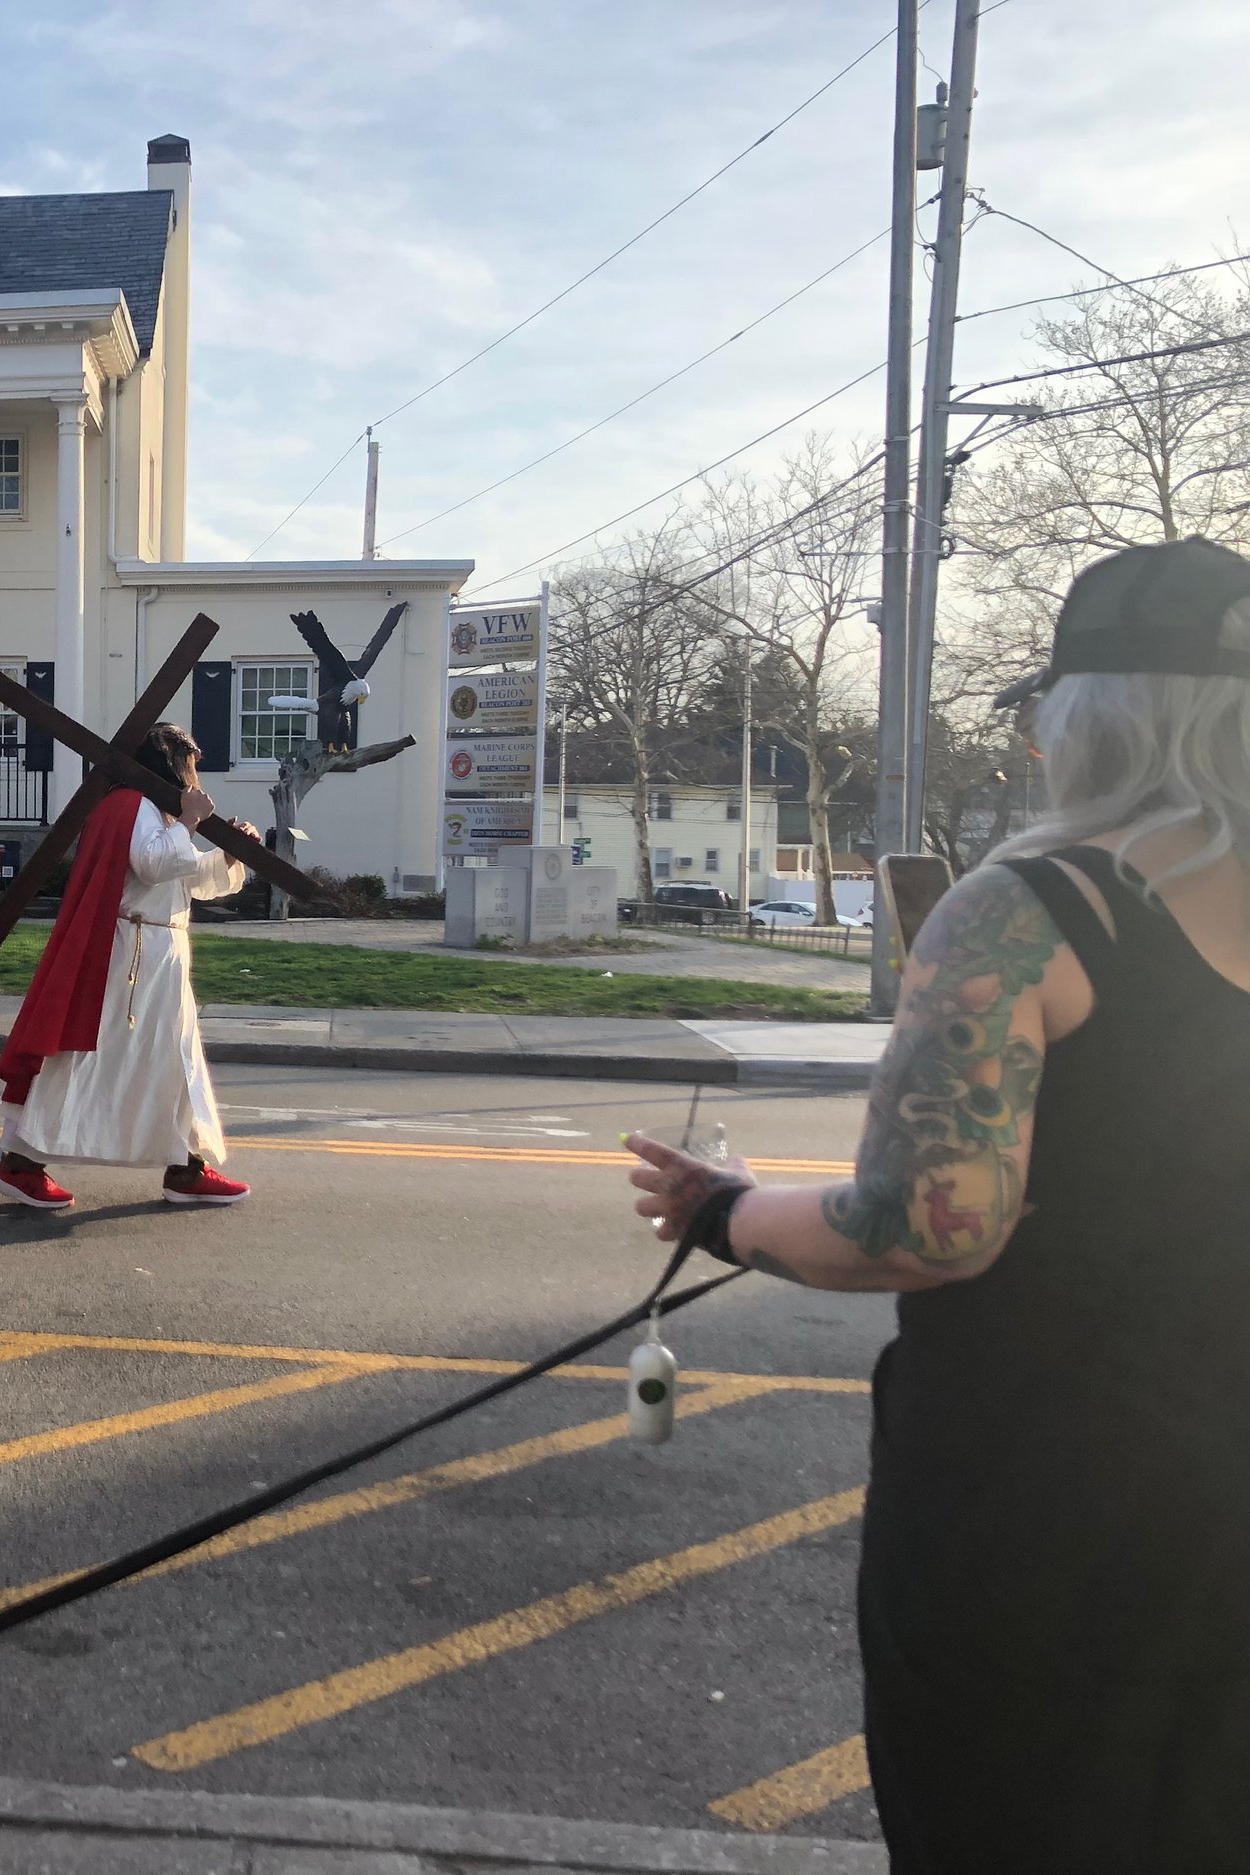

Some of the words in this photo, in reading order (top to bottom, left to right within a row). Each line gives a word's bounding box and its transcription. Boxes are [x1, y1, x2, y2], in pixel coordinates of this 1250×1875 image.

[482, 613, 532, 634] VFW
[478, 675, 534, 688] AMERICAN
[485, 689, 526, 700] LEGION
[473, 744, 507, 752] MARINE
[508, 743, 535, 751] CORPS
[475, 817, 486, 825] OF
